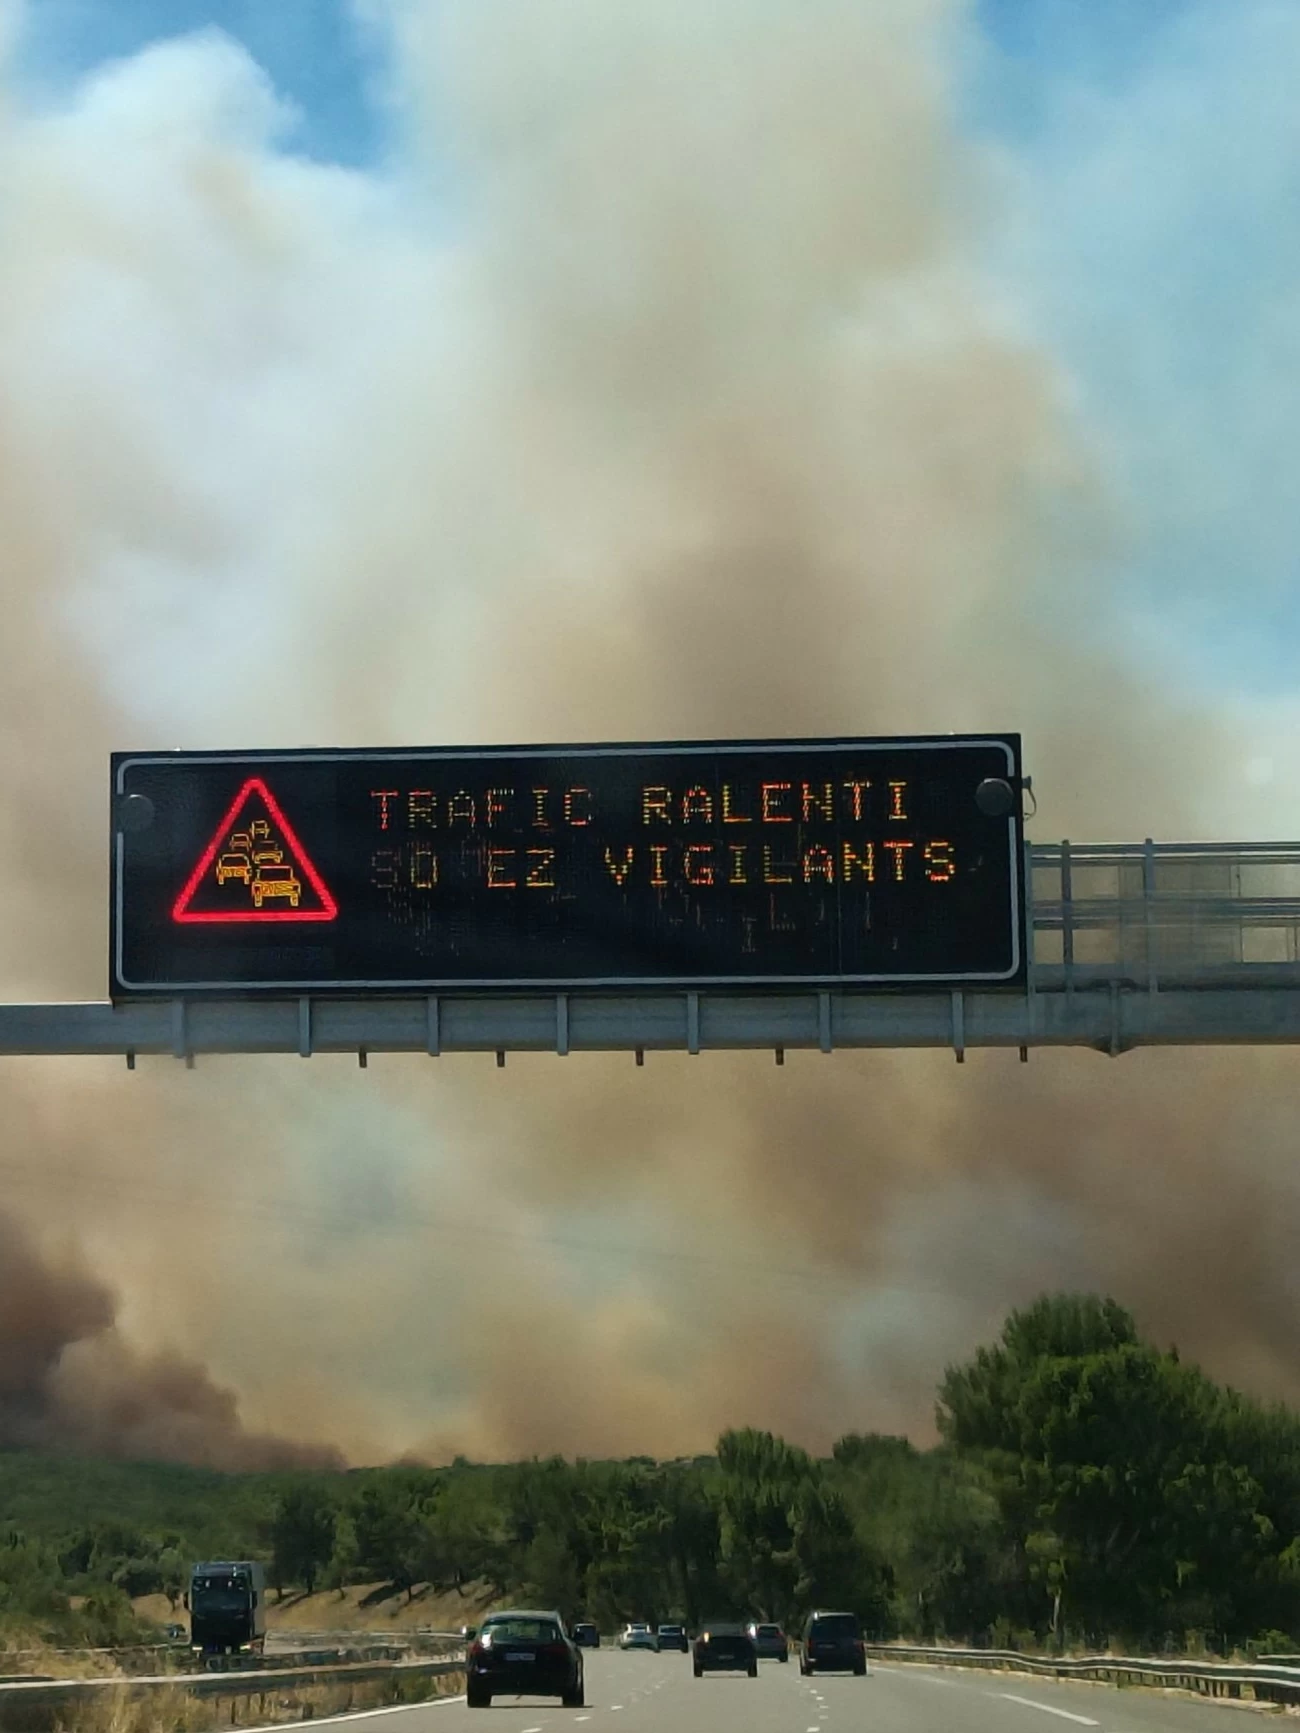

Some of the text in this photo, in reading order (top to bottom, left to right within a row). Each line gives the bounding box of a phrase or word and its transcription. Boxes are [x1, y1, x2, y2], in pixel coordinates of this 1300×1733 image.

[370, 780, 908, 830] TRAFIC RALENTI
[371, 840, 956, 889] SOEZ VIGILANTS
